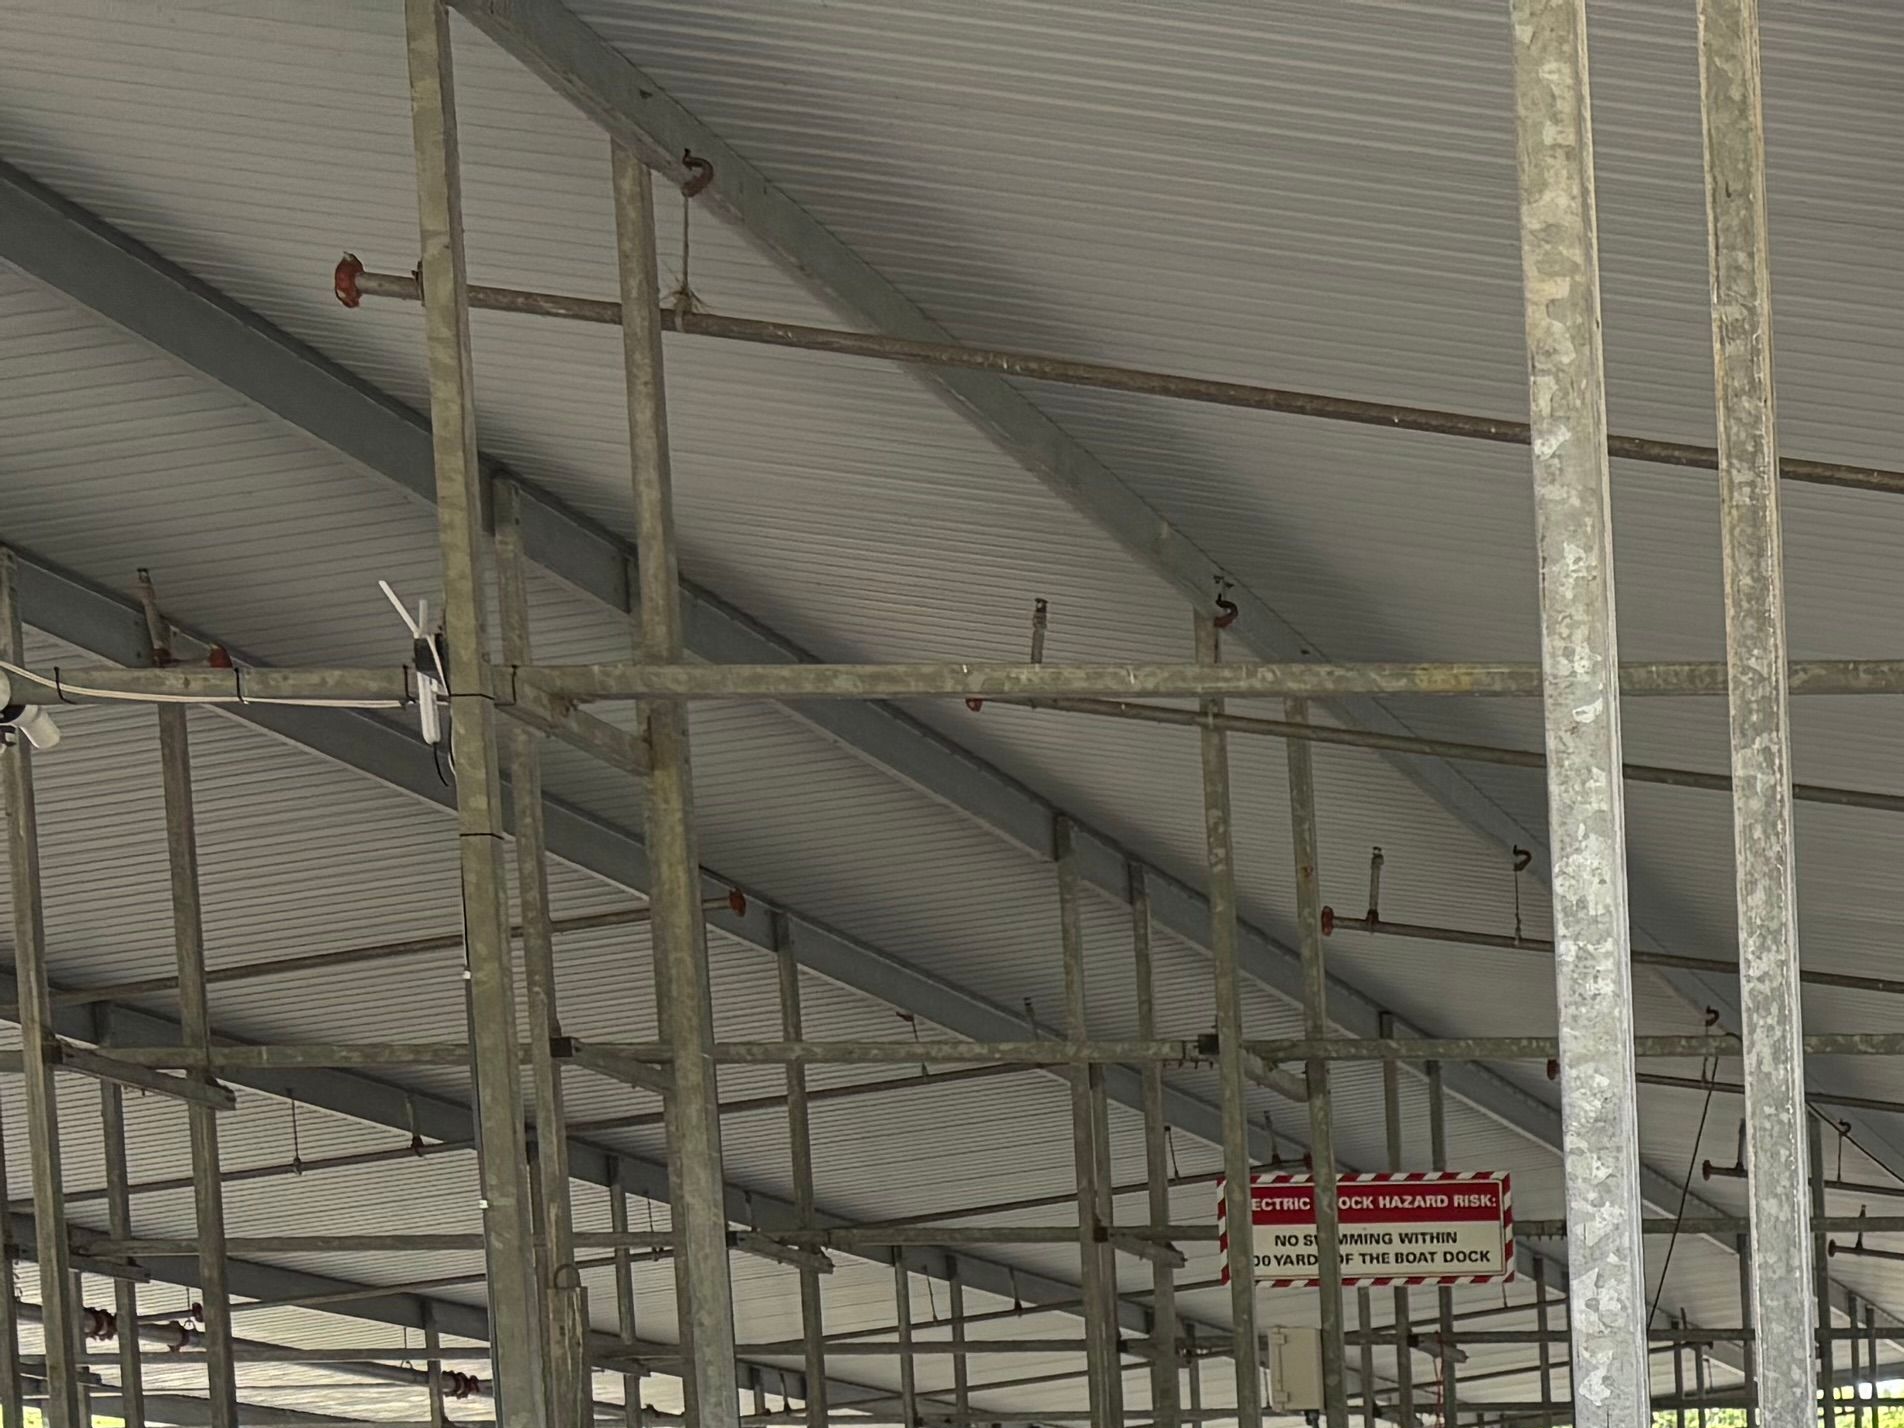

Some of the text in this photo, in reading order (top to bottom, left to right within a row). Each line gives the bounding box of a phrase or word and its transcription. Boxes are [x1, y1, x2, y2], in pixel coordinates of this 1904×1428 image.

[1251, 1194, 1497, 1211] ECTRIC OCK HAZARD RISK:
[1274, 1234, 1299, 1247] NO
[1398, 1231, 1458, 1245] WITHIN
[1273, 1253, 1319, 1267] YARD
[1359, 1252, 1390, 1265] THE
[1394, 1251, 1437, 1264] BOAT
[1443, 1250, 1490, 1263] DOCK
